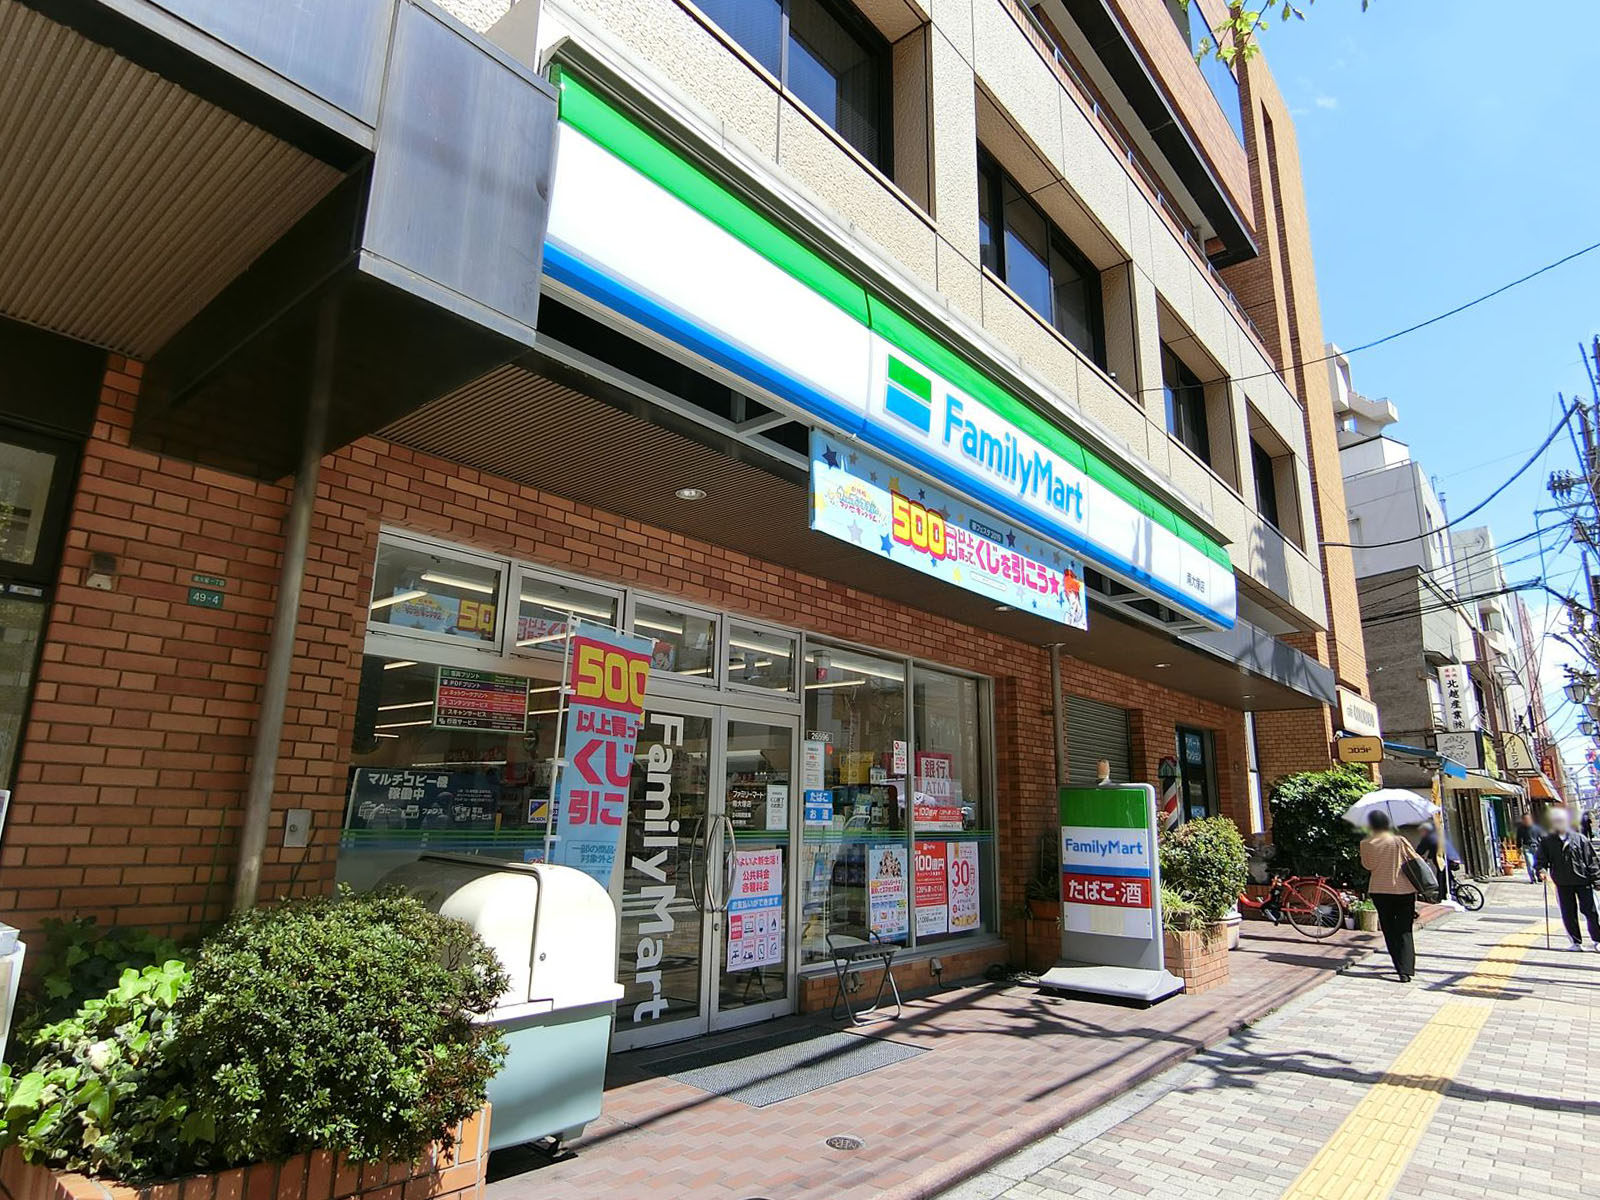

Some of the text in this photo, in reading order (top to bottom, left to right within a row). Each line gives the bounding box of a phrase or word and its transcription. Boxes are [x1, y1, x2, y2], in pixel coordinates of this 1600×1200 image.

[943, 393, 1083, 520] FamilyMart
[193, 592, 219, 605] 49-4
[577, 644, 650, 706] 500
[447, 709, 487, 718] スキャンサービス
[573, 739, 634, 788] くじ
[924, 759, 946, 779] 銀行
[368, 773, 449, 789] マルチコピー機
[925, 781, 946, 795] ATM
[732, 790, 764, 800] ファミリーマート
[1065, 838, 1143, 857] FamilyMart
[632, 713, 684, 1023] FamilyMart
[743, 869, 770, 881] 公共料金
[951, 887, 976, 899] クーポン
[1068, 879, 1142, 905] たばこ・酒
